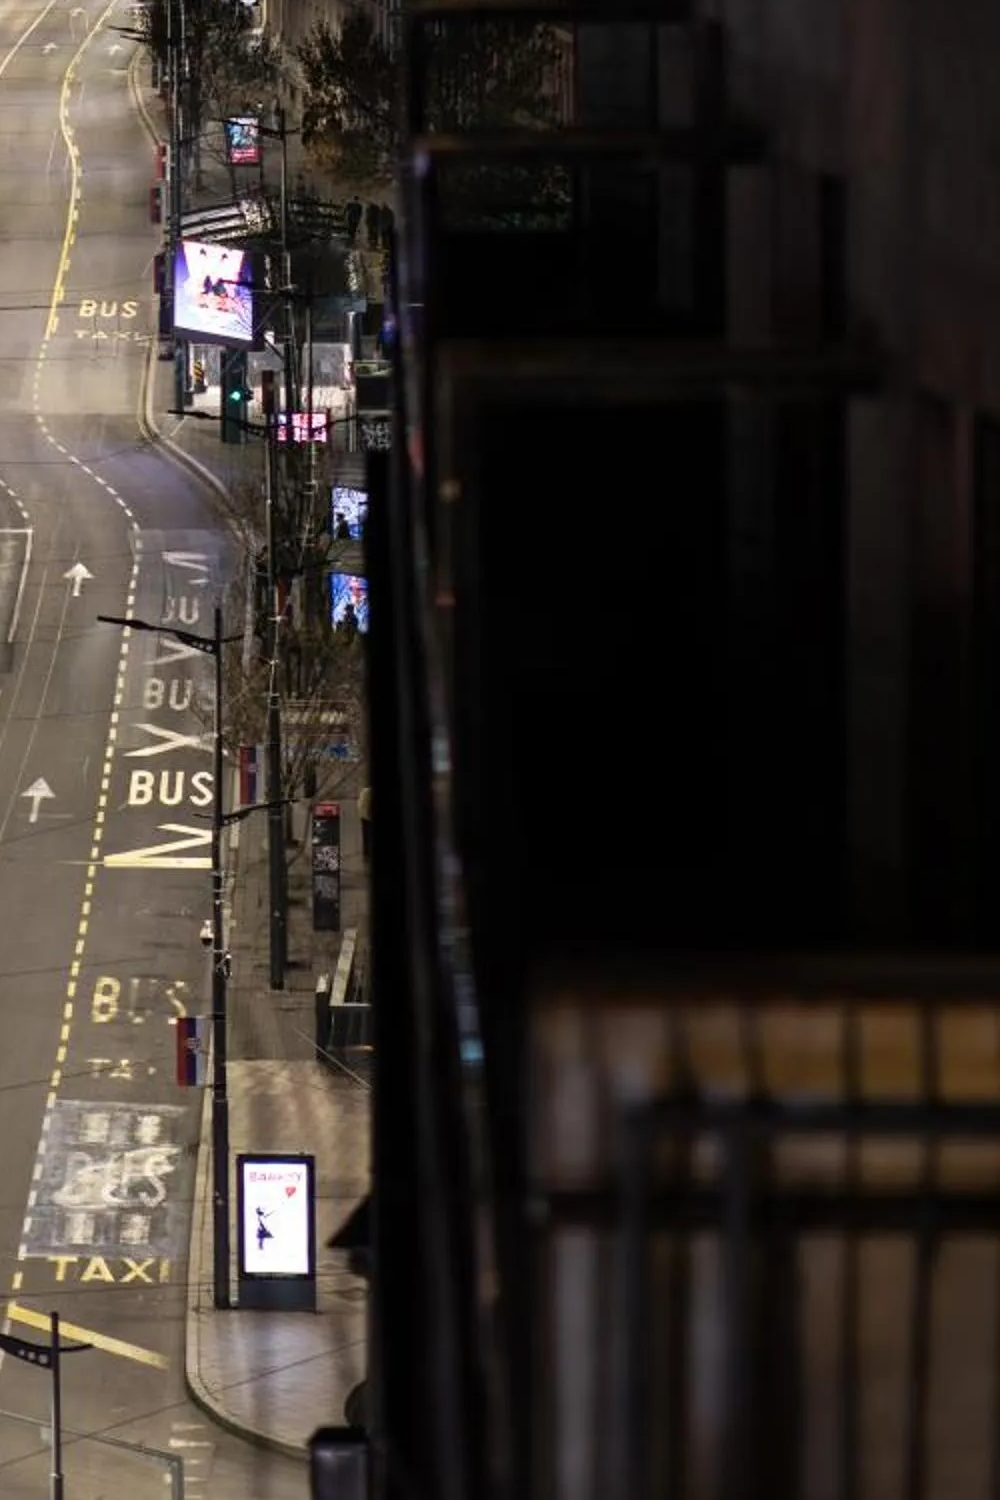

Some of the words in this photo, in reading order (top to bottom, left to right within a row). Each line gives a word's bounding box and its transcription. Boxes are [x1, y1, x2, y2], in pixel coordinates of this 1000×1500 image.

[79, 299, 139, 319] BUS
[127, 769, 215, 807] BUS
[47, 1254, 172, 1284] TAXI
